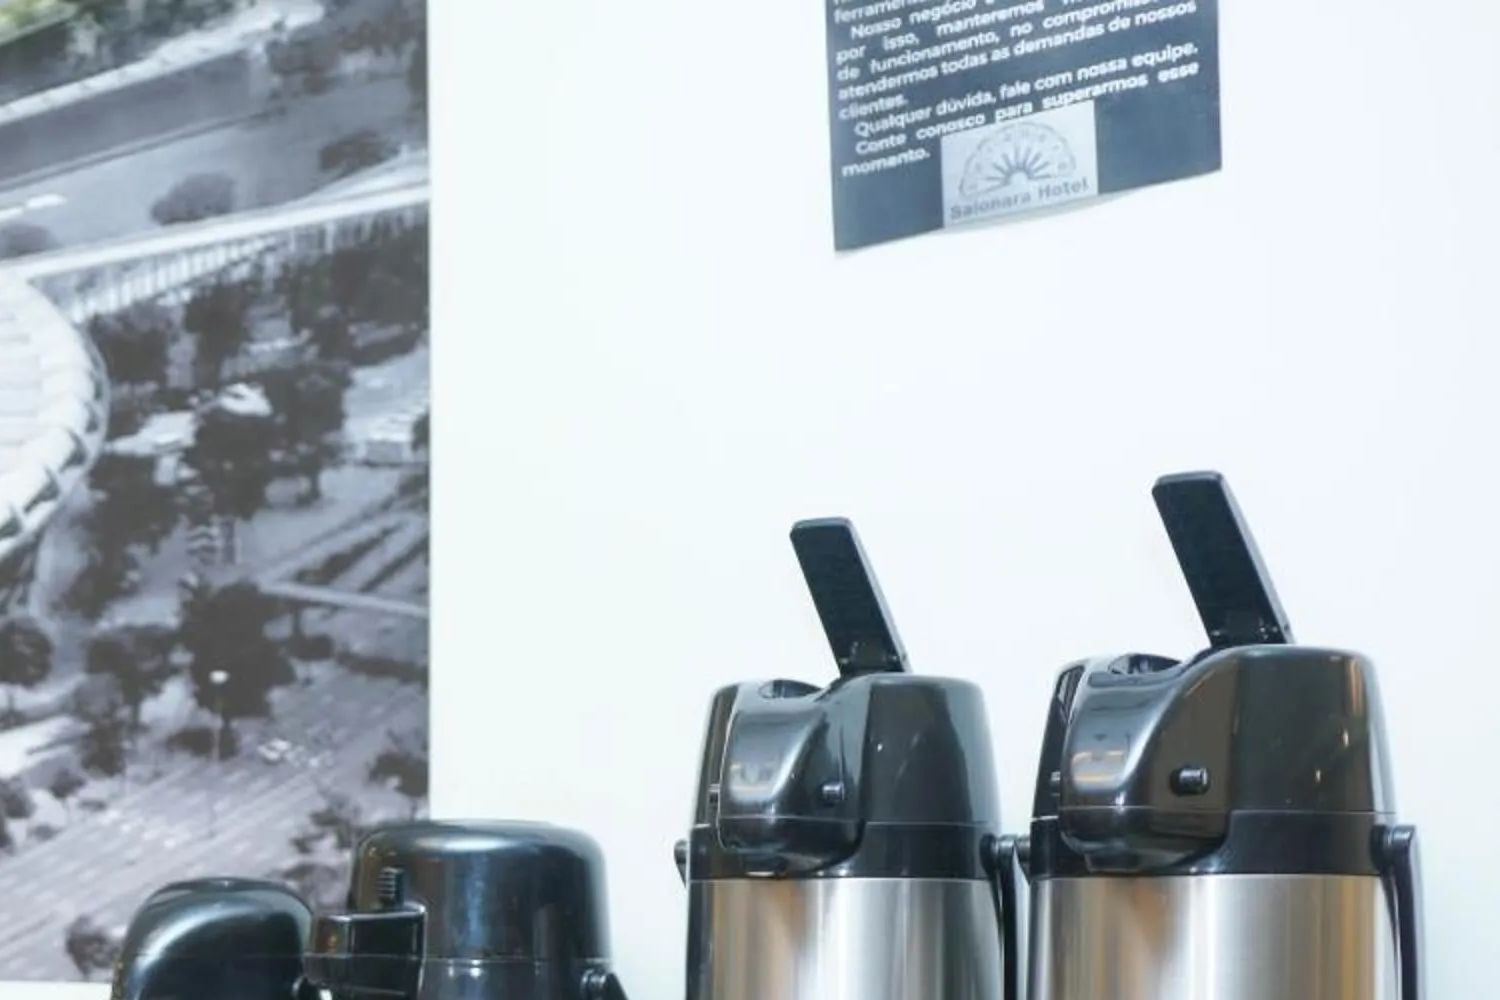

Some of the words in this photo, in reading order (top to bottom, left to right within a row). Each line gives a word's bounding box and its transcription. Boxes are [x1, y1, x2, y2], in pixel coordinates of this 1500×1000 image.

[836, 45, 866, 66] por
[882, 32, 920, 51] isso,
[936, 0, 1045, 37] manteremos
[836, 65, 861, 81] de
[870, 31, 1000, 74] funcionamento,
[1010, 22, 1033, 38] no
[838, 65, 939, 100] atendermos
[940, 52, 989, 75] todas
[990, 46, 1011, 61] as
[1012, 22, 1105, 57] demandas
[1108, 15, 1131, 32] de
[1135, 0, 1198, 27] nossos
[851, 17, 902, 39] Nosso
[854, 106, 933, 137] Qualquer
[999, 79, 1031, 100] fale
[1034, 71, 1073, 91] com
[1077, 57, 1128, 81] nossa
[1131, 42, 1199, 69] equipe.
[855, 133, 907, 155] Conte
[915, 113, 986, 140] conosco
[994, 101, 1033, 123] para
[1041, 74, 1149, 110] superarmos
[1157, 62, 1199, 83] esse
[841, 147, 931, 178] momento.
[1038, 176, 1090, 200] Hotel
